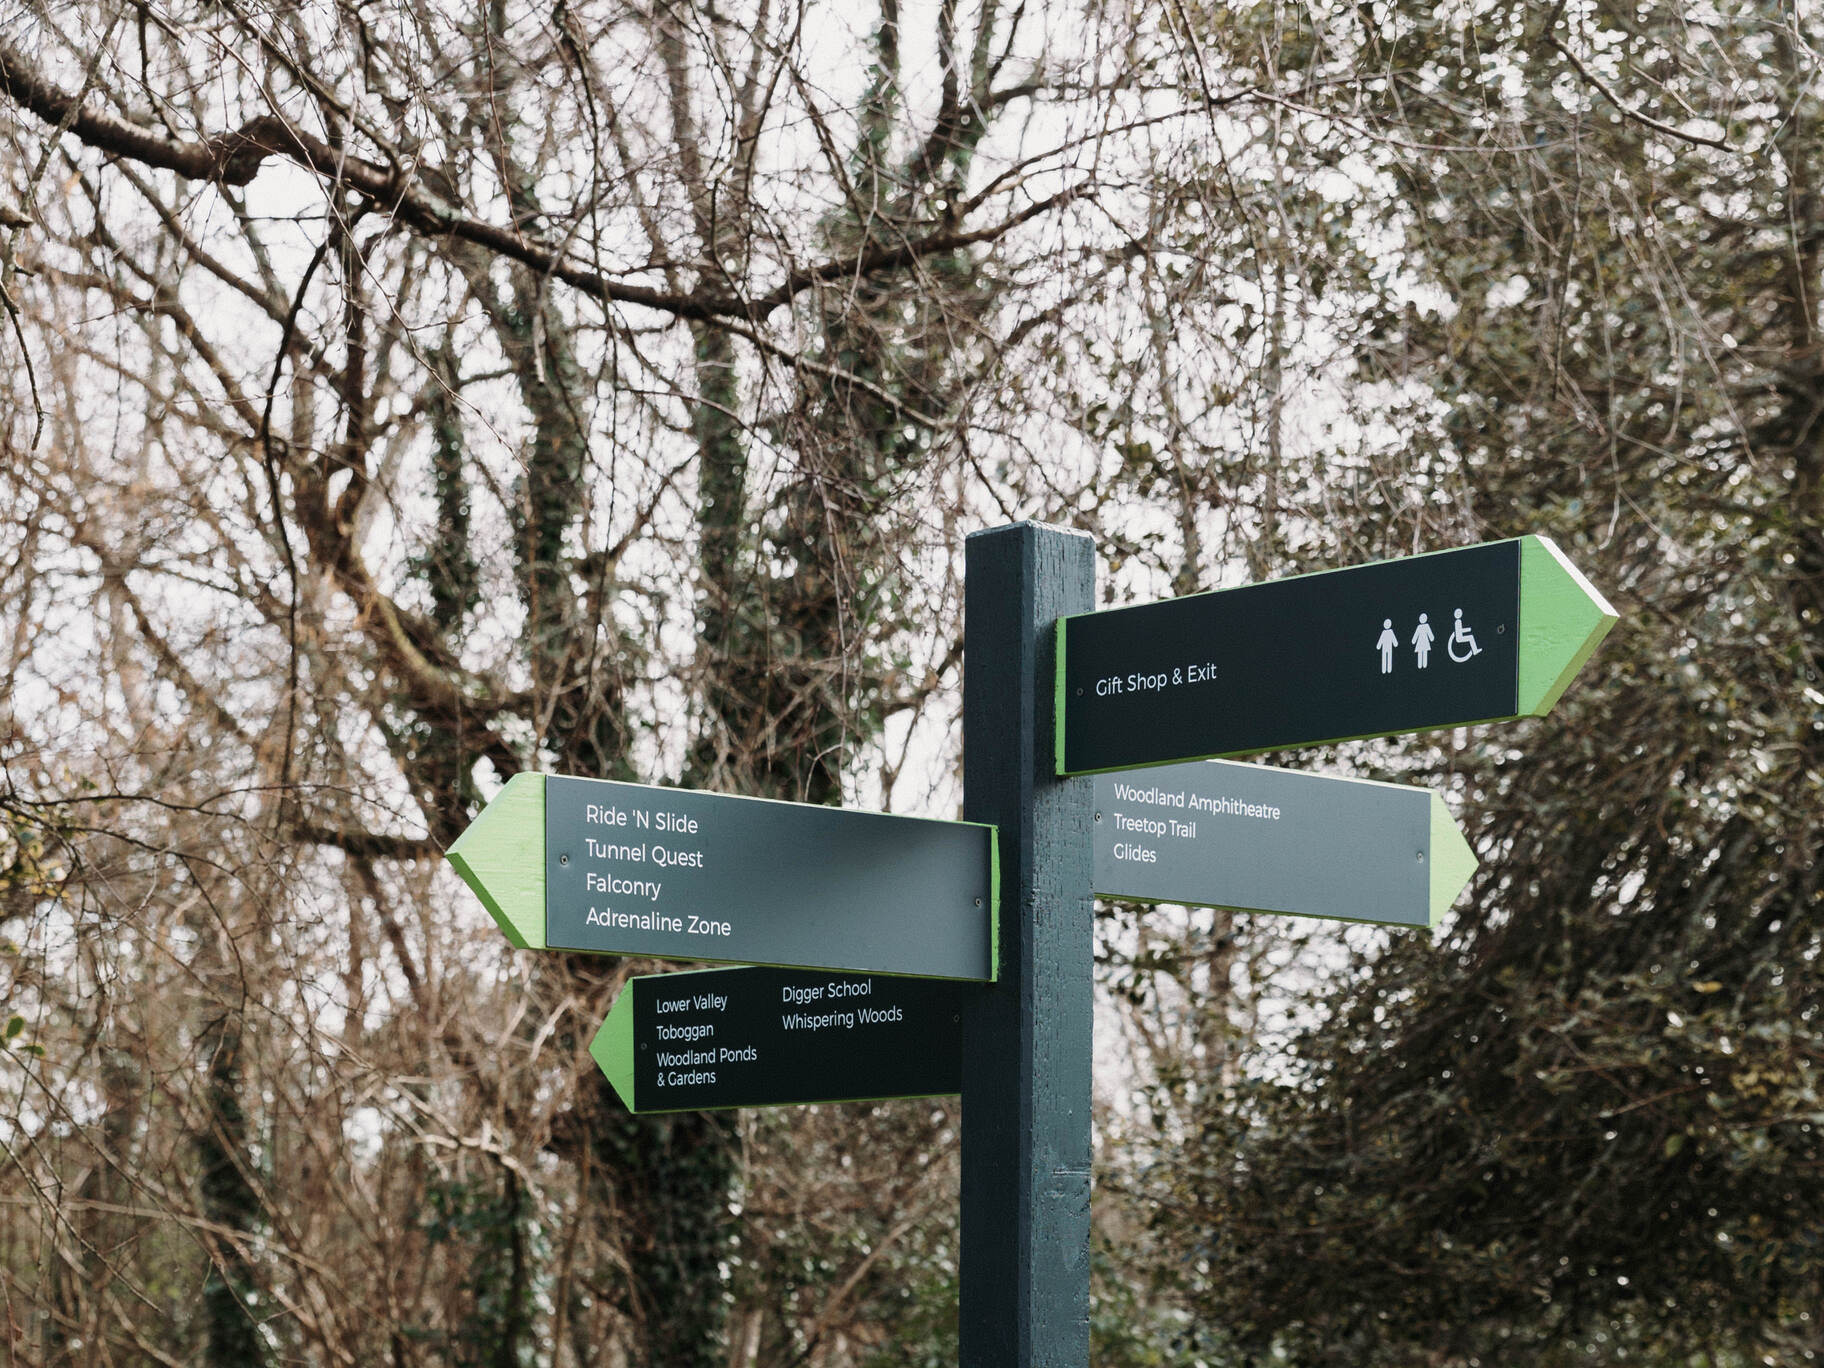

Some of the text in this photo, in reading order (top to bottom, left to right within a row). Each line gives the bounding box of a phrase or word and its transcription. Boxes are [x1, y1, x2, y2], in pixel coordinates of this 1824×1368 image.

[1096, 662, 1217, 696] Gift Shop & Exit
[1114, 783, 1280, 820] Woodland Amphitheatre
[586, 804, 698, 834] Ride 'N Slide
[1114, 813, 1196, 839] Treetop Trail
[585, 838, 703, 868] Tunnel Quest
[1113, 843, 1157, 863] Glides
[586, 873, 661, 901] Falconry
[586, 907, 731, 936] Adrenaline Zone
[656, 993, 728, 1014] Lower Valley
[782, 978, 872, 1005] Digger School
[782, 1005, 903, 1031] Whispering Woods
[656, 1023, 714, 1042] Toboggan
[656, 1046, 757, 1067] Woodland Ponds
[657, 1070, 716, 1087] & Gardens
